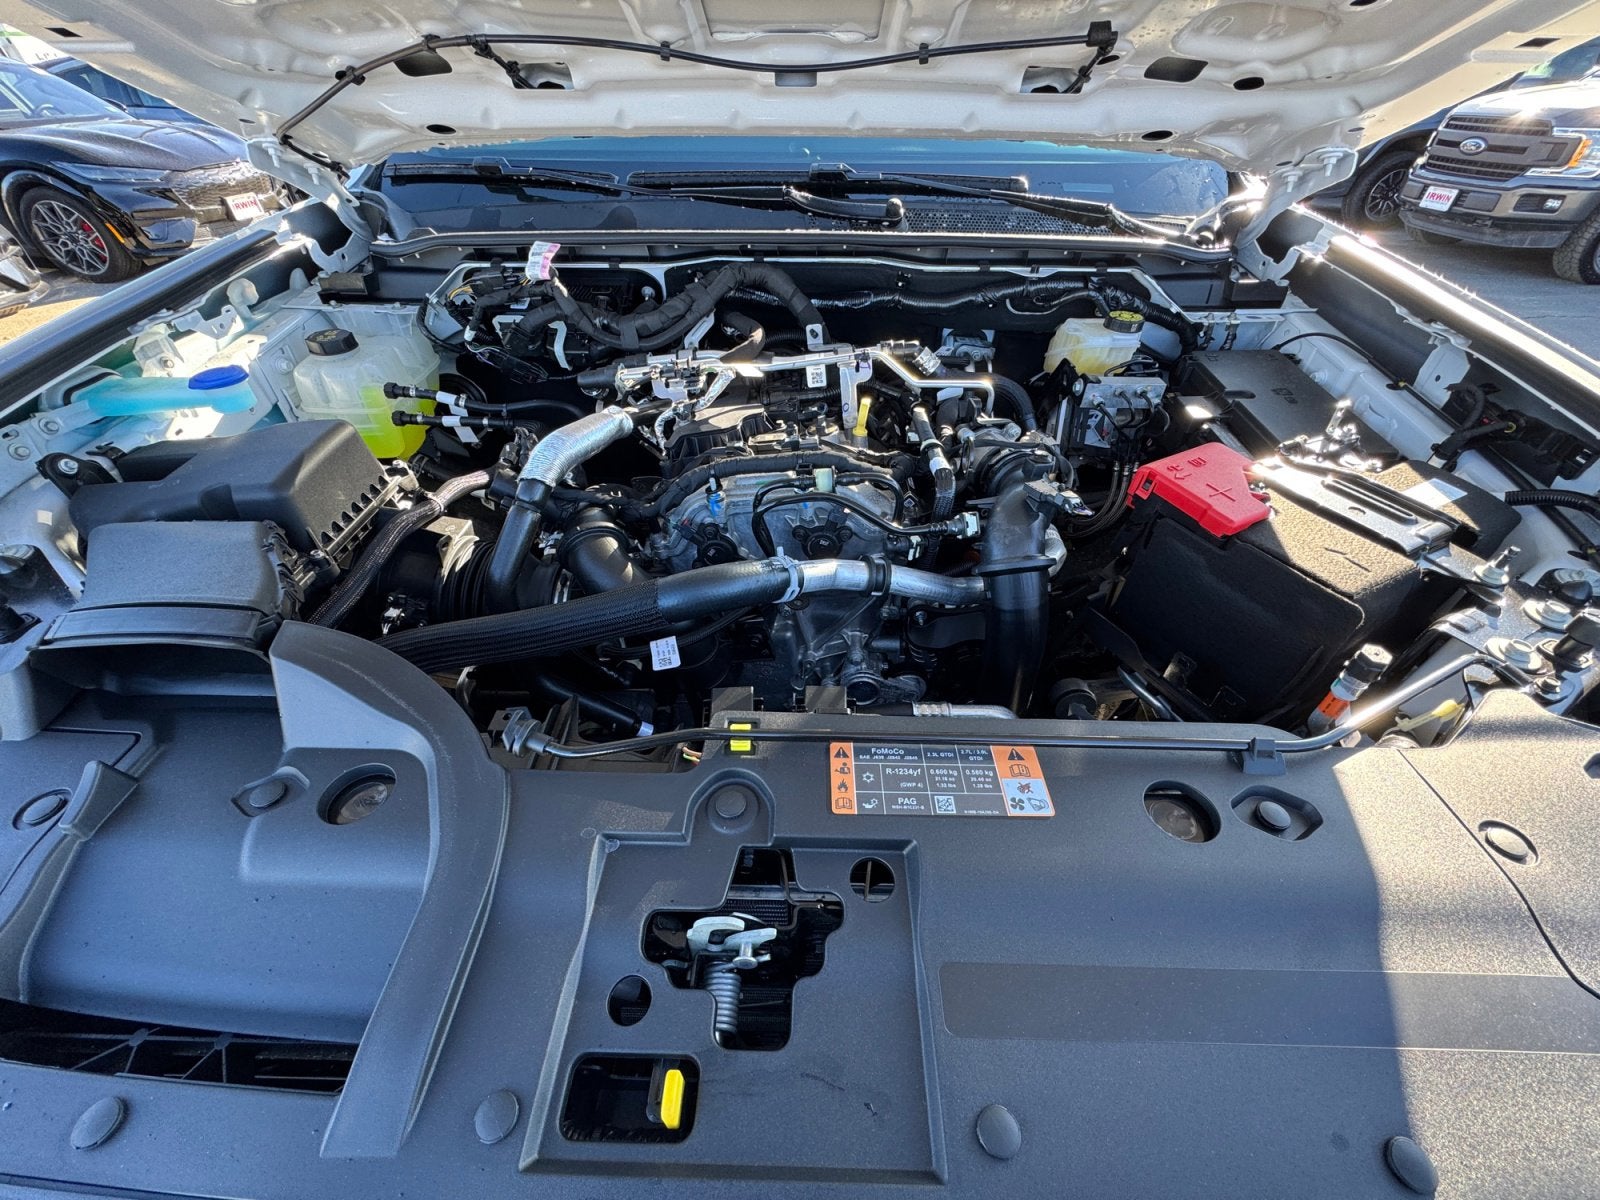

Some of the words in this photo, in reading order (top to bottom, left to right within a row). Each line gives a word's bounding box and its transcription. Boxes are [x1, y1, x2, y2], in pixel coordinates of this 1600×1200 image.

[1426, 191, 1452, 203] IRWIN
[871, 747, 904, 755] FoMoCo
[885, 767, 921, 777] R-1234yf
[984, 769, 993, 777] kg
[898, 797, 917, 805] PAG
